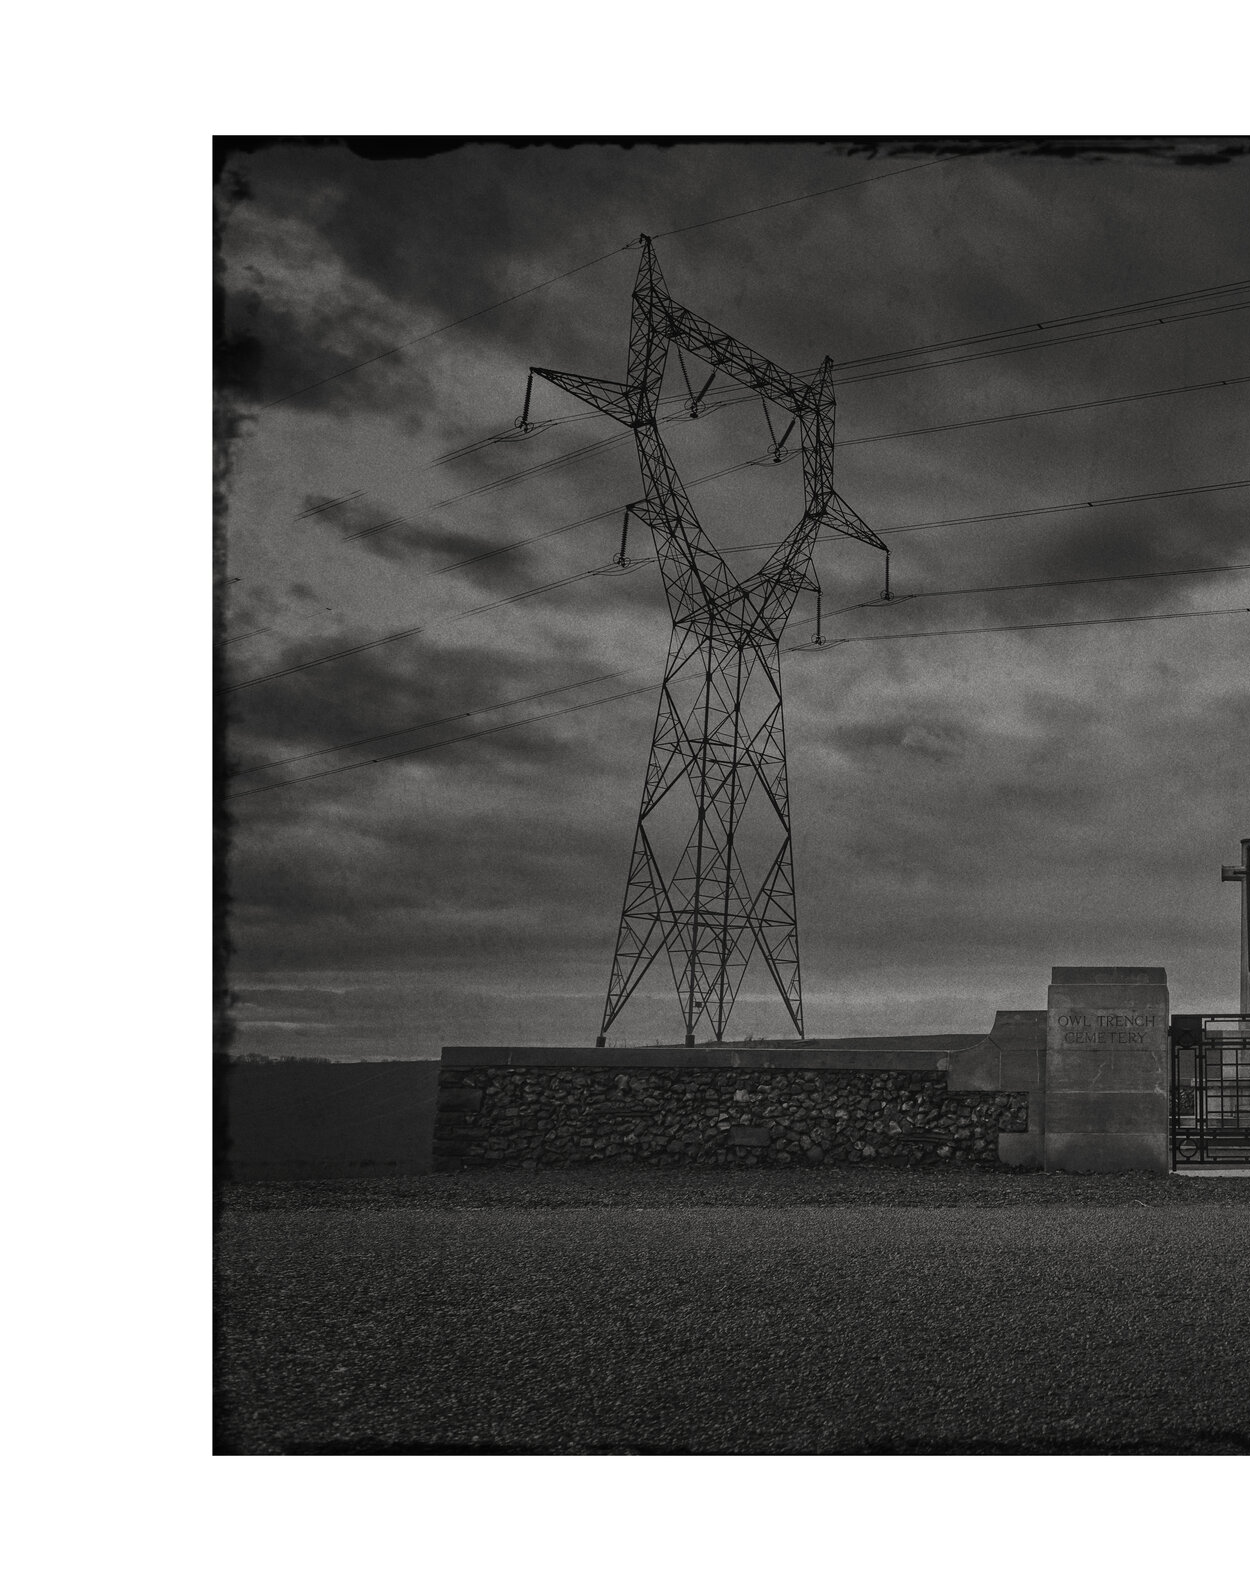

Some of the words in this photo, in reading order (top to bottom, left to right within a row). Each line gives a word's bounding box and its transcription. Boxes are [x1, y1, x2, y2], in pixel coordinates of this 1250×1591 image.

[1058, 1015, 1091, 1027] OWL
[1097, 1015, 1155, 1027] TRENCH
[1064, 1032, 1148, 1044] CEMETERY
